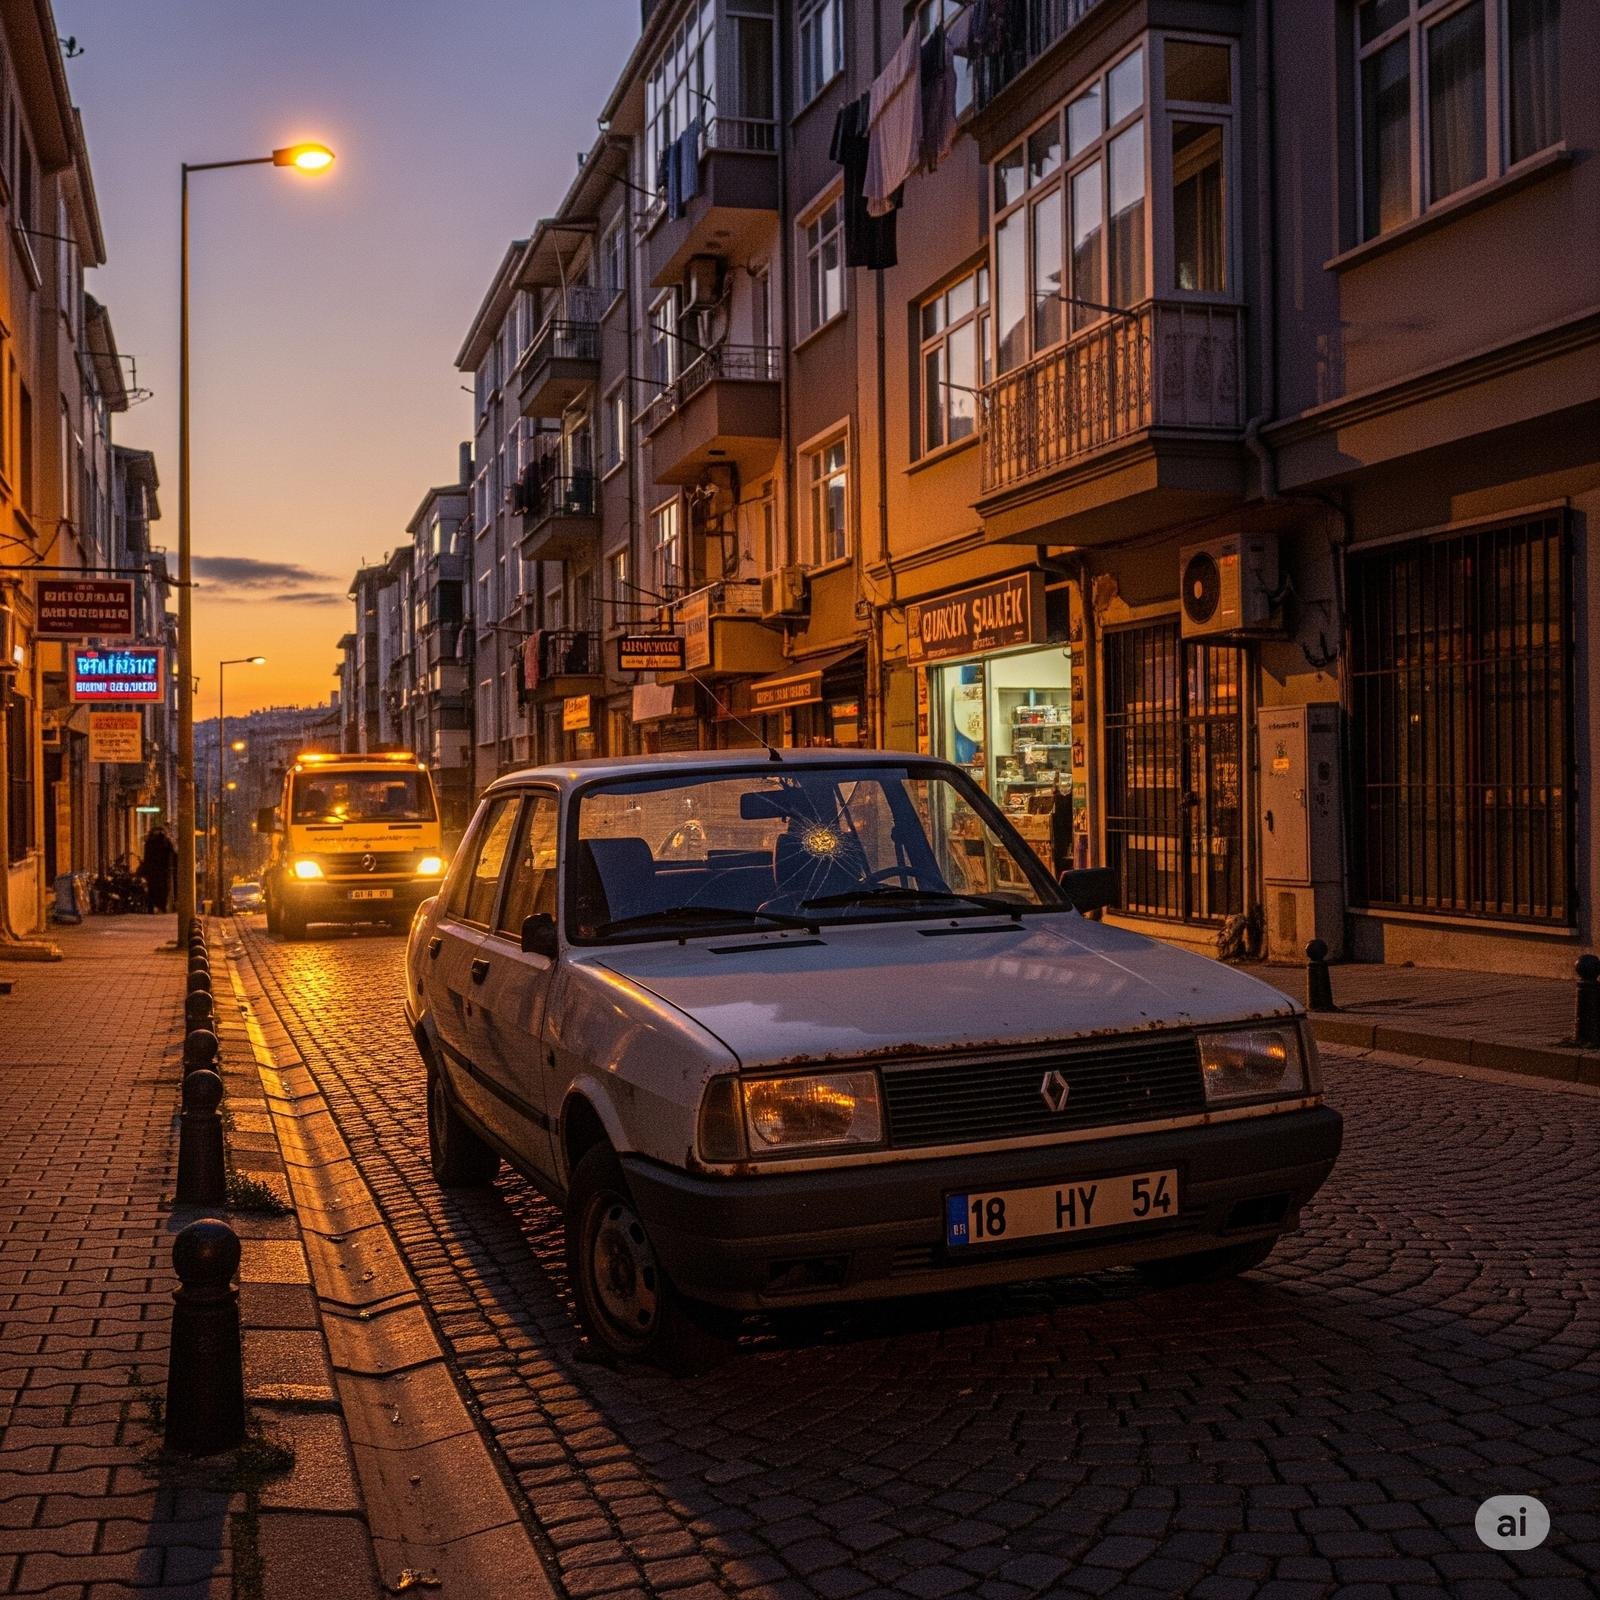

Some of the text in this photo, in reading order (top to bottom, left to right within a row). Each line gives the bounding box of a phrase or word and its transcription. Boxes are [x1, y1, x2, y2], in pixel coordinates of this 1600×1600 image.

[971, 1175, 1171, 1239] 18 HY 54
